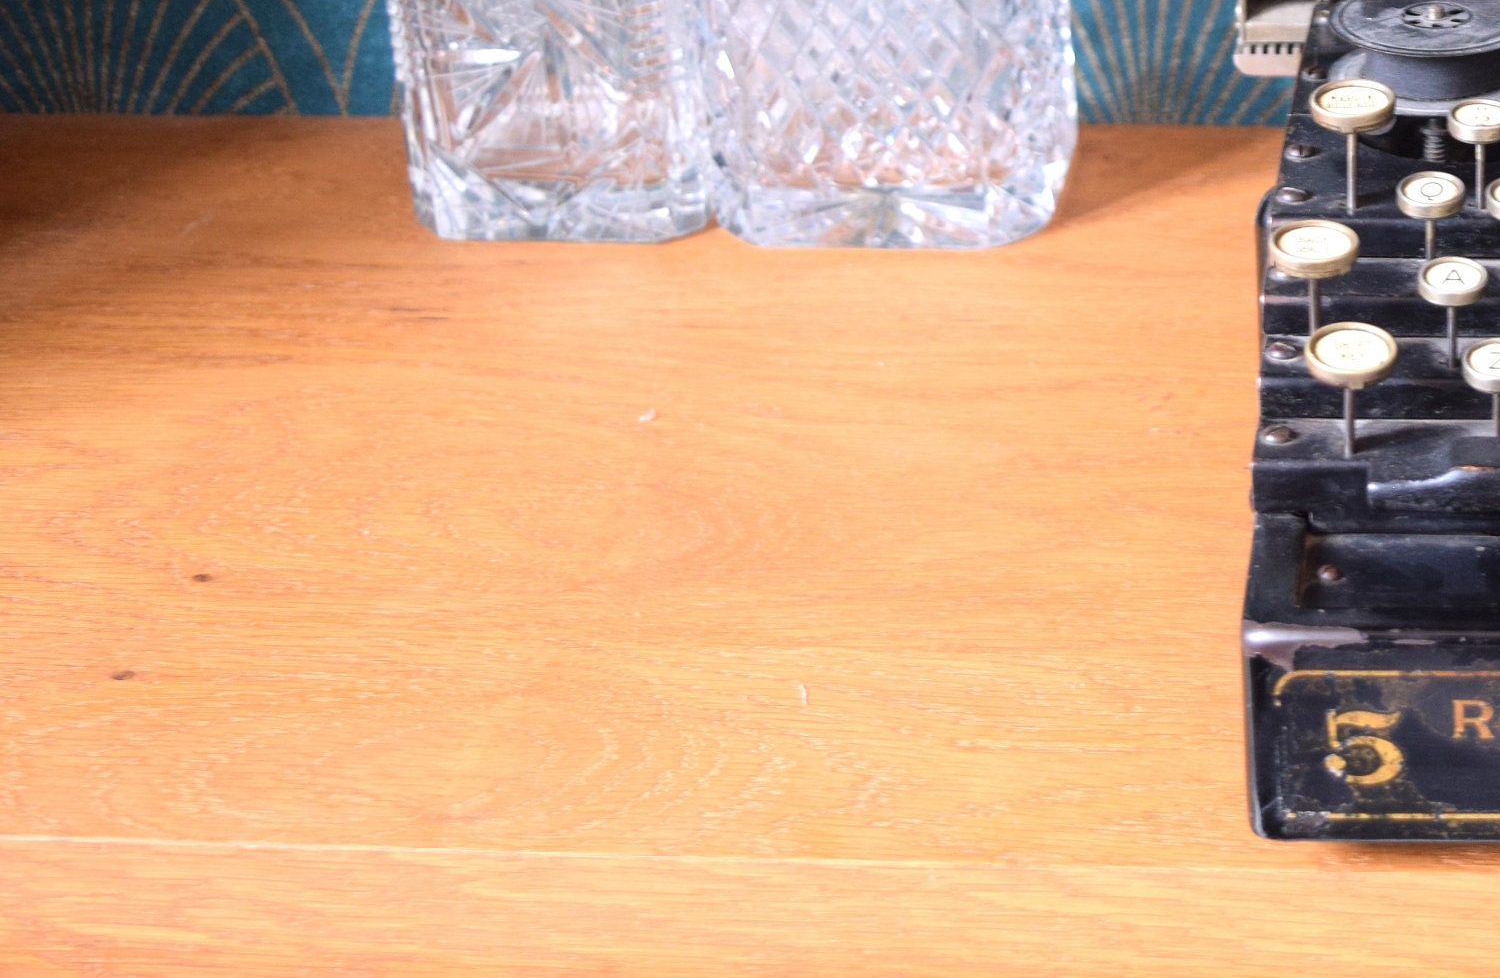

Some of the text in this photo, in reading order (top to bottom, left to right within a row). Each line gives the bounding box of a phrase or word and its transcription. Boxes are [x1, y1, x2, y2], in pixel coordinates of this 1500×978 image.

[1419, 181, 1444, 201] Q
[1441, 269, 1465, 285] A
[1325, 709, 1404, 786] 5
